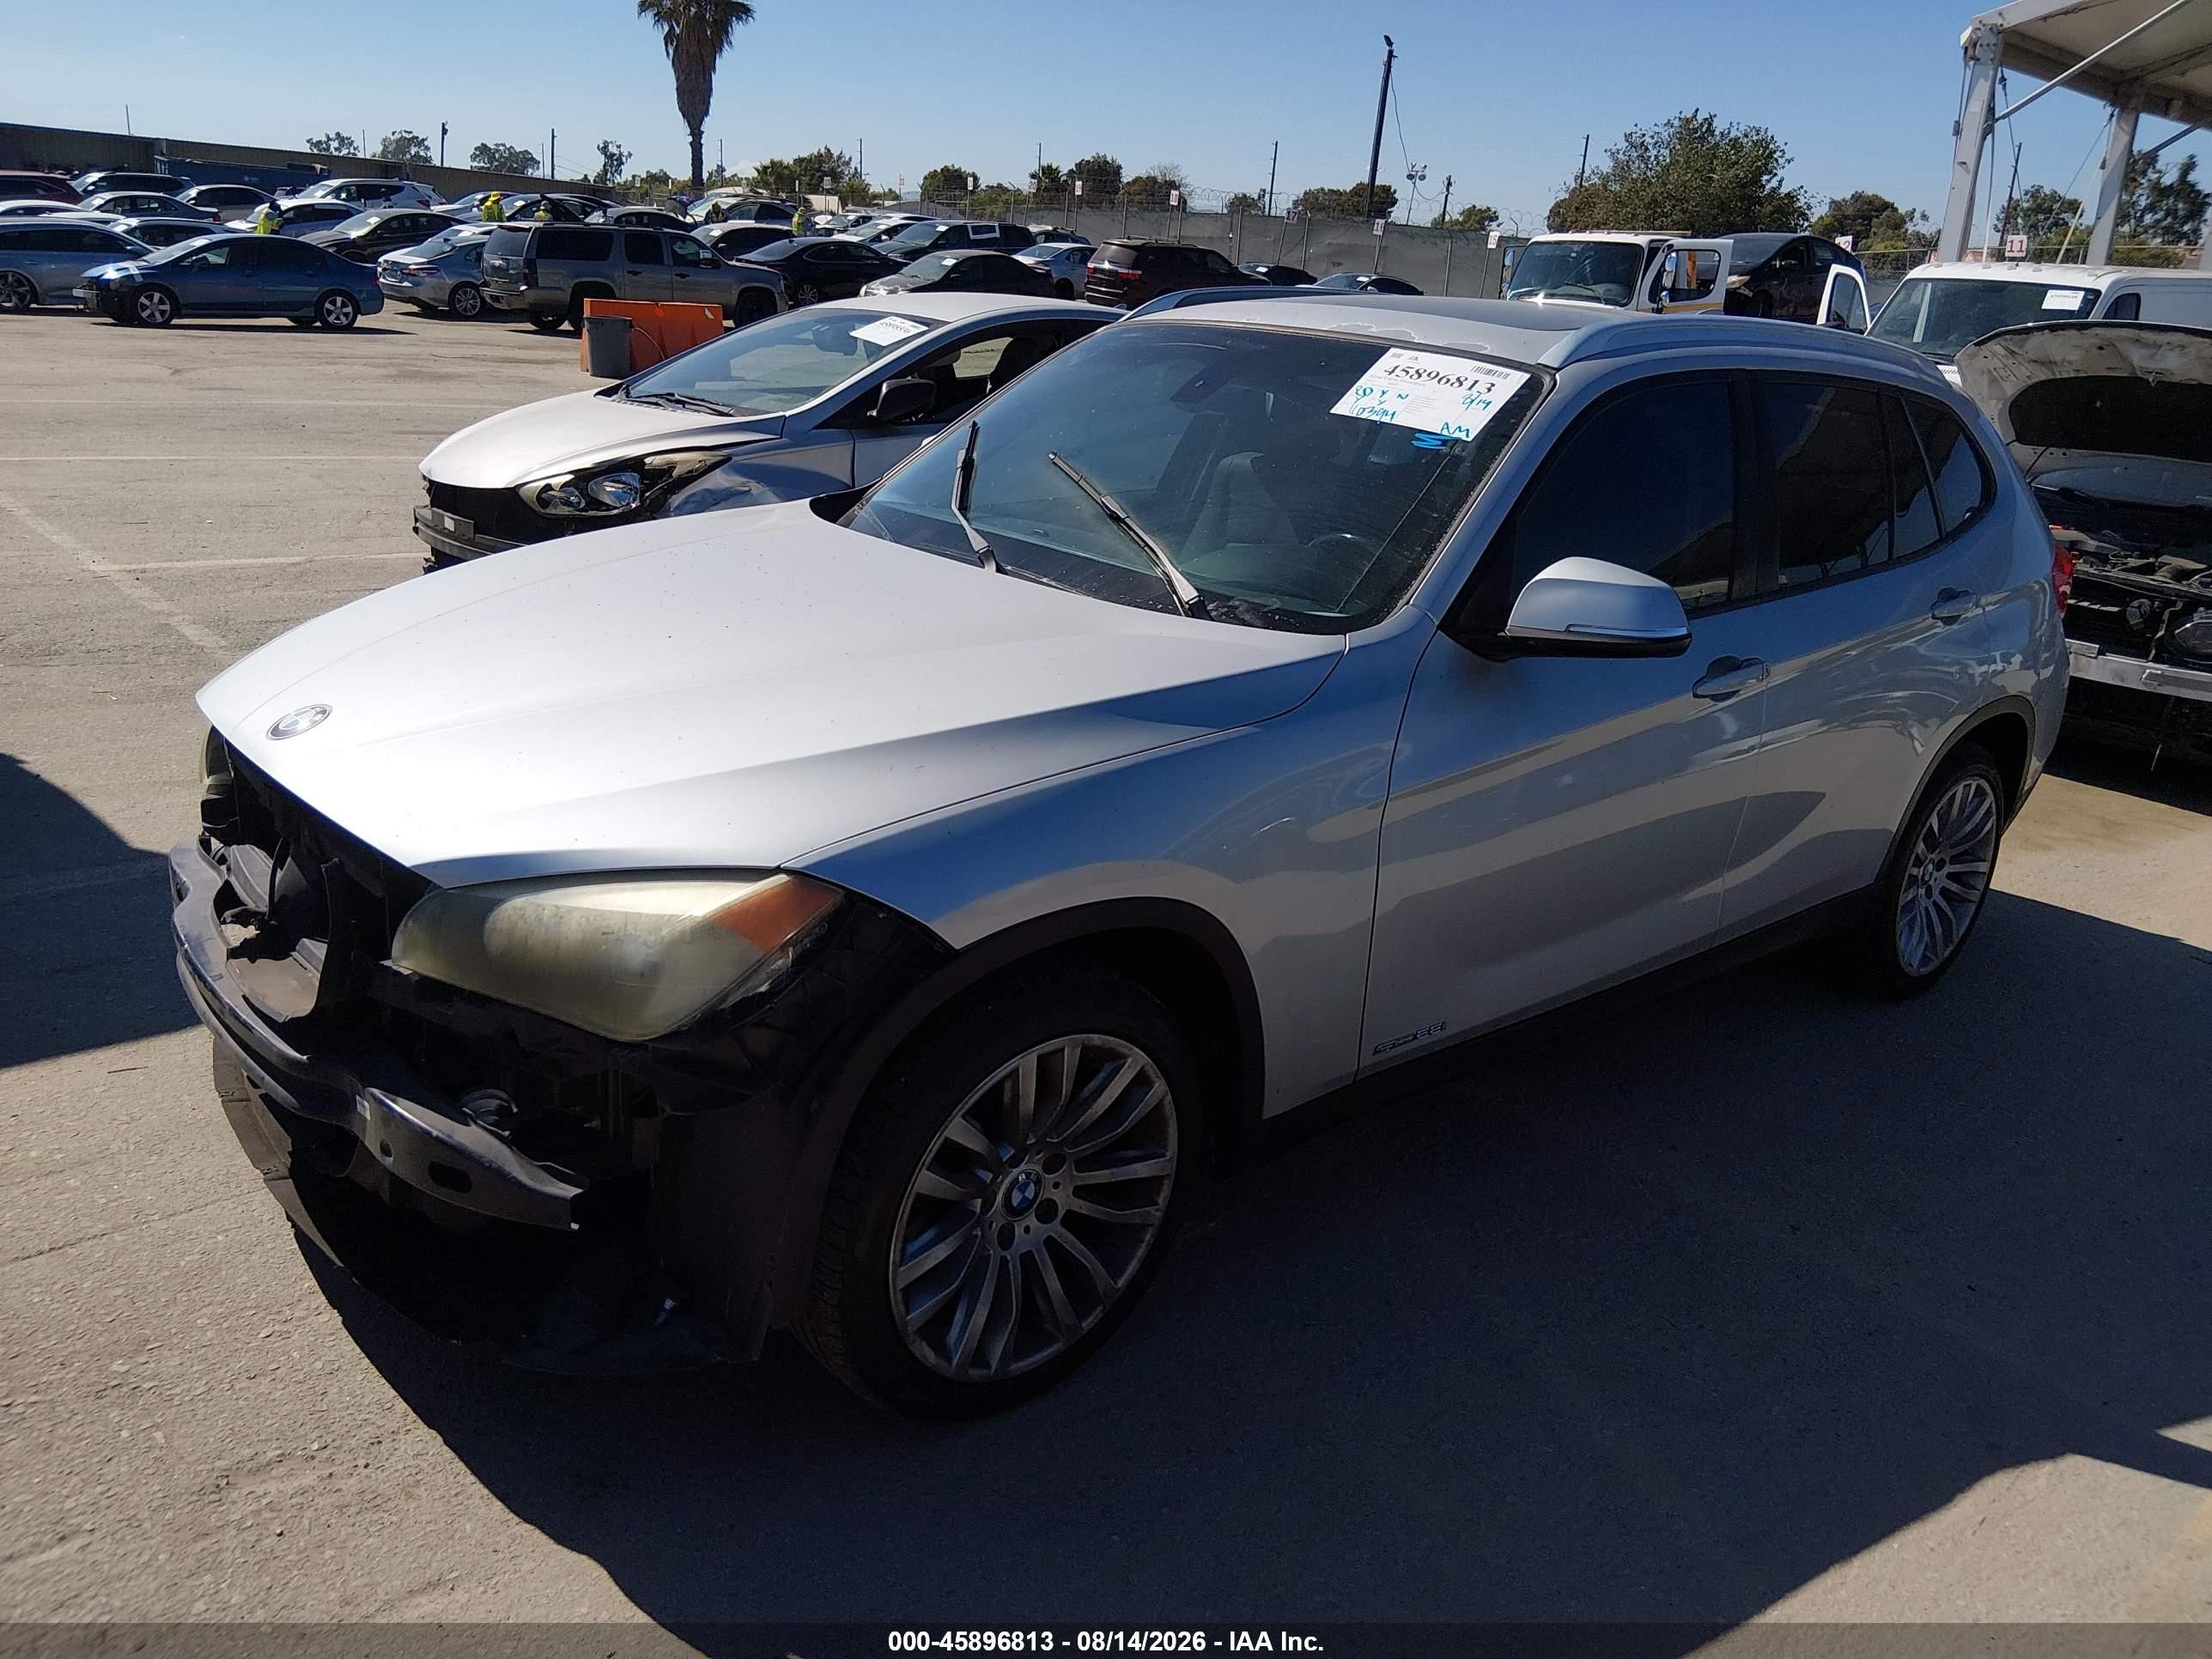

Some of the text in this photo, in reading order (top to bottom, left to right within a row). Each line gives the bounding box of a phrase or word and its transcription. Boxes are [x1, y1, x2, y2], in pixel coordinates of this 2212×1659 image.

[1285, 210, 1297, 221] 17
[1489, 234, 1498, 246] 15
[2007, 240, 2025, 252] 11
[1384, 364, 1496, 394] 45896813
